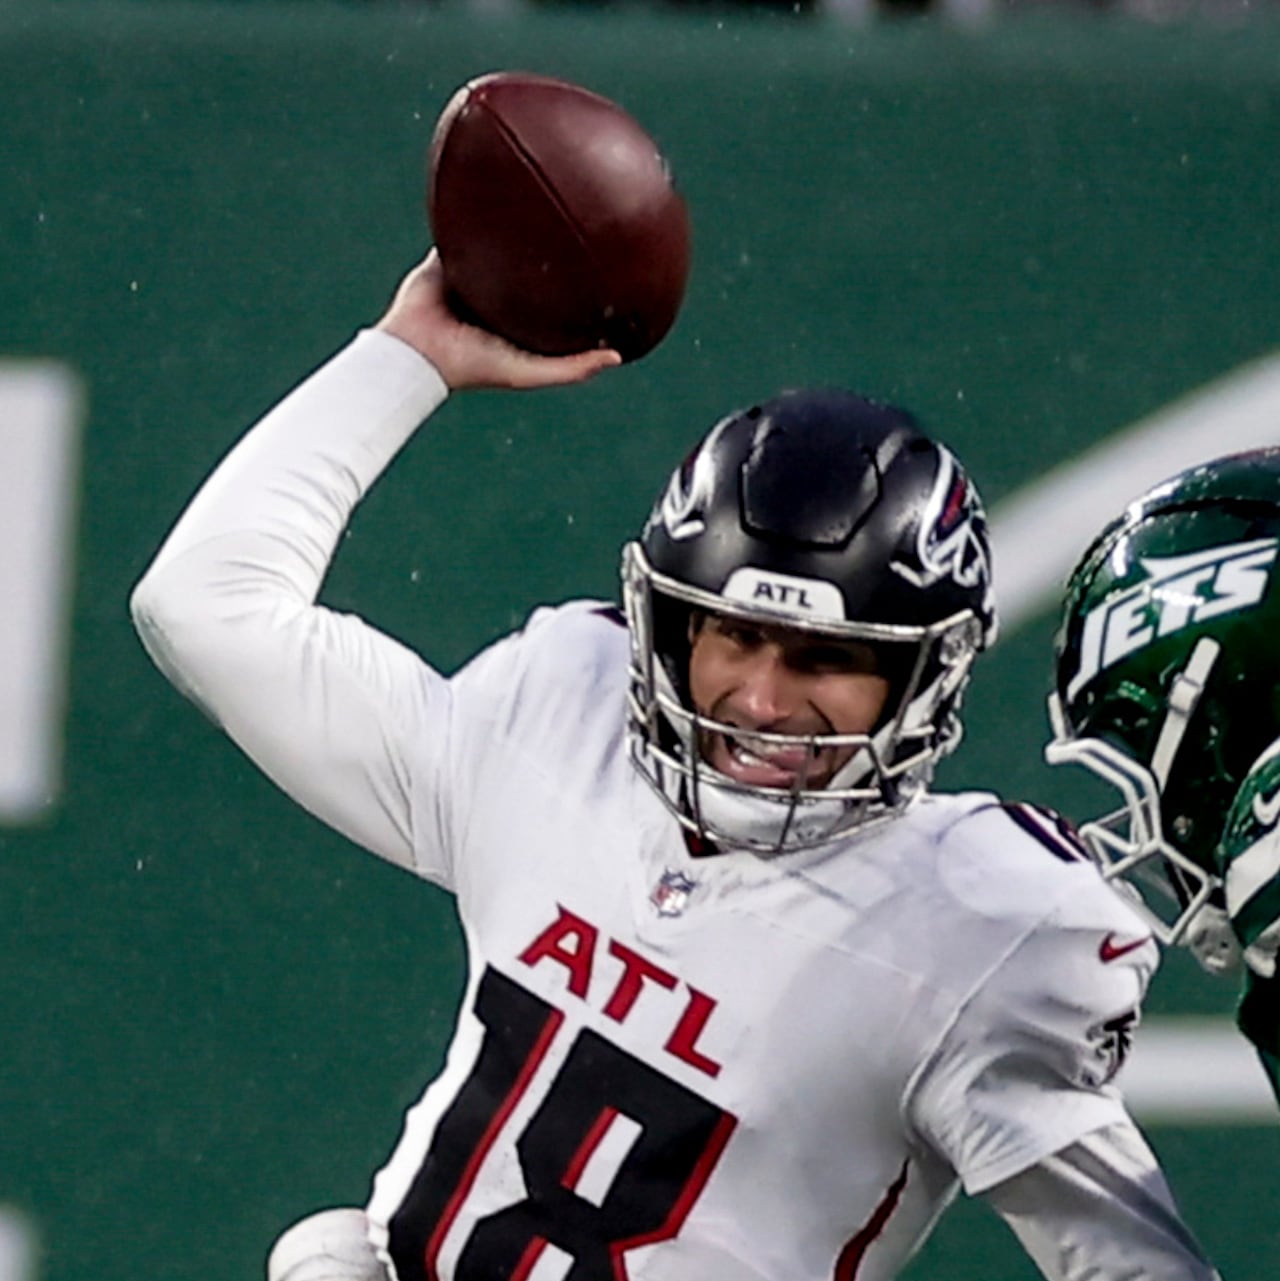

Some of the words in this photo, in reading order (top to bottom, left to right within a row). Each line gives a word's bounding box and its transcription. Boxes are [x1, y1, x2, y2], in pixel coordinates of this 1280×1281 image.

[752, 580, 813, 610] ATL
[1066, 537, 1280, 705] JETS
[516, 901, 724, 1080] ATL
